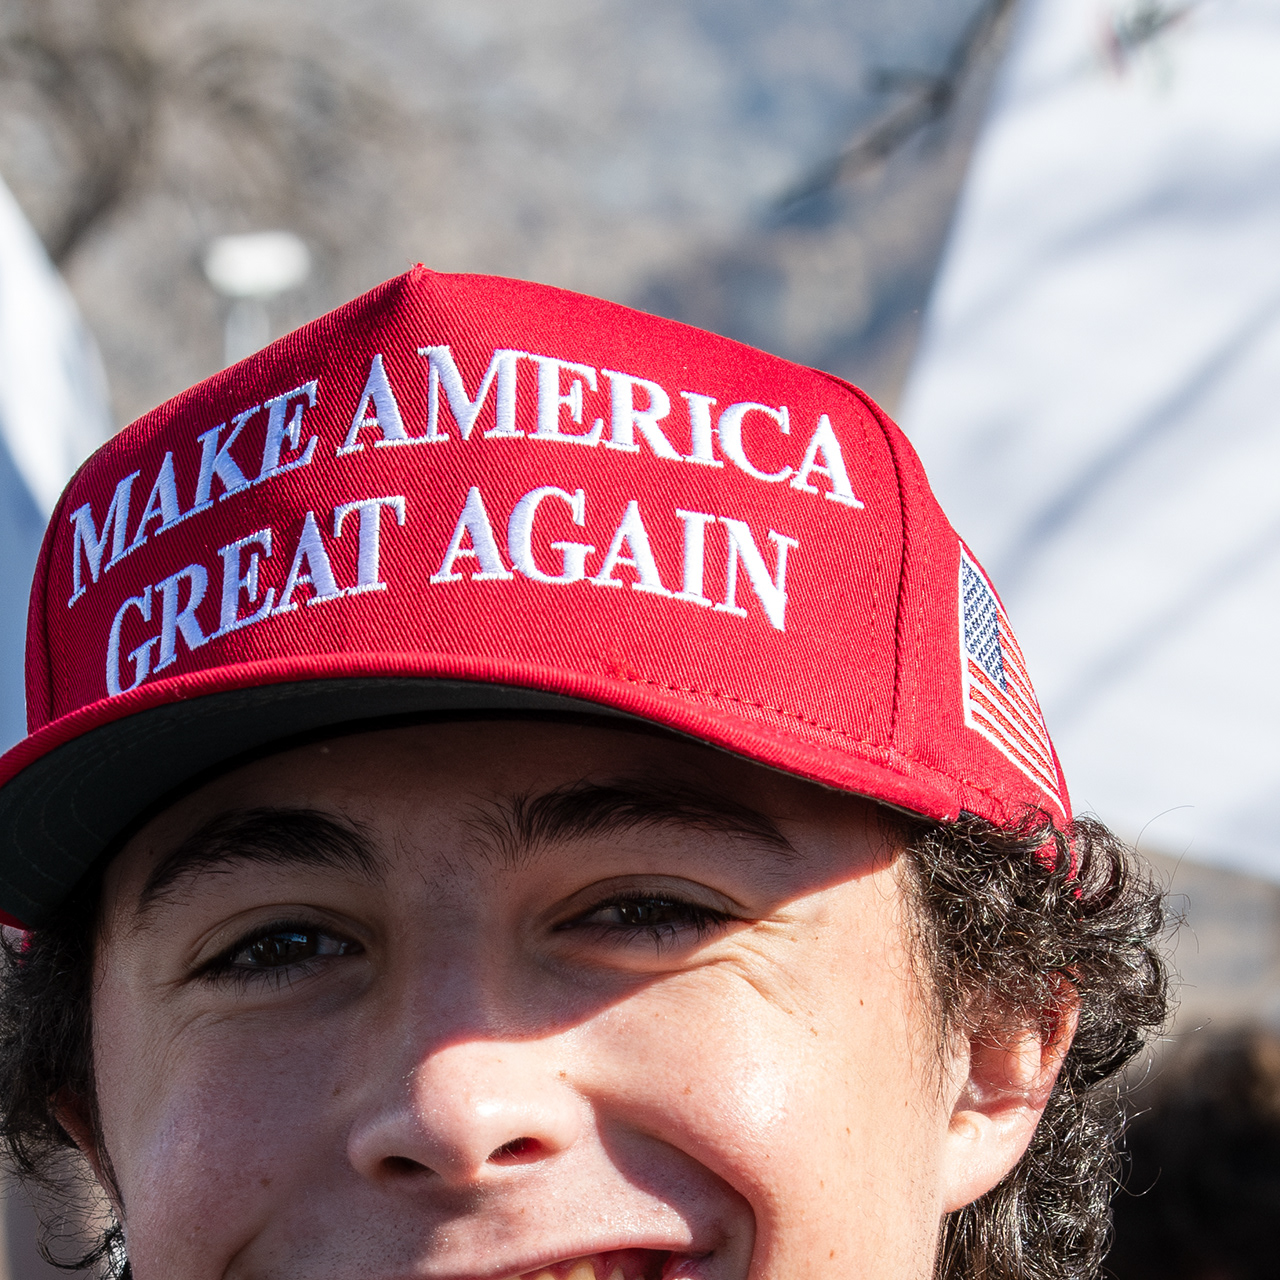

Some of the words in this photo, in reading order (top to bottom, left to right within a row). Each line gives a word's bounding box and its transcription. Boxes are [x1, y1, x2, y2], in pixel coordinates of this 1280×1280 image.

[67, 379, 321, 609] MAKE
[335, 344, 866, 511] AMERICA
[105, 494, 408, 699] GREAT
[429, 485, 801, 632] AGAIN
